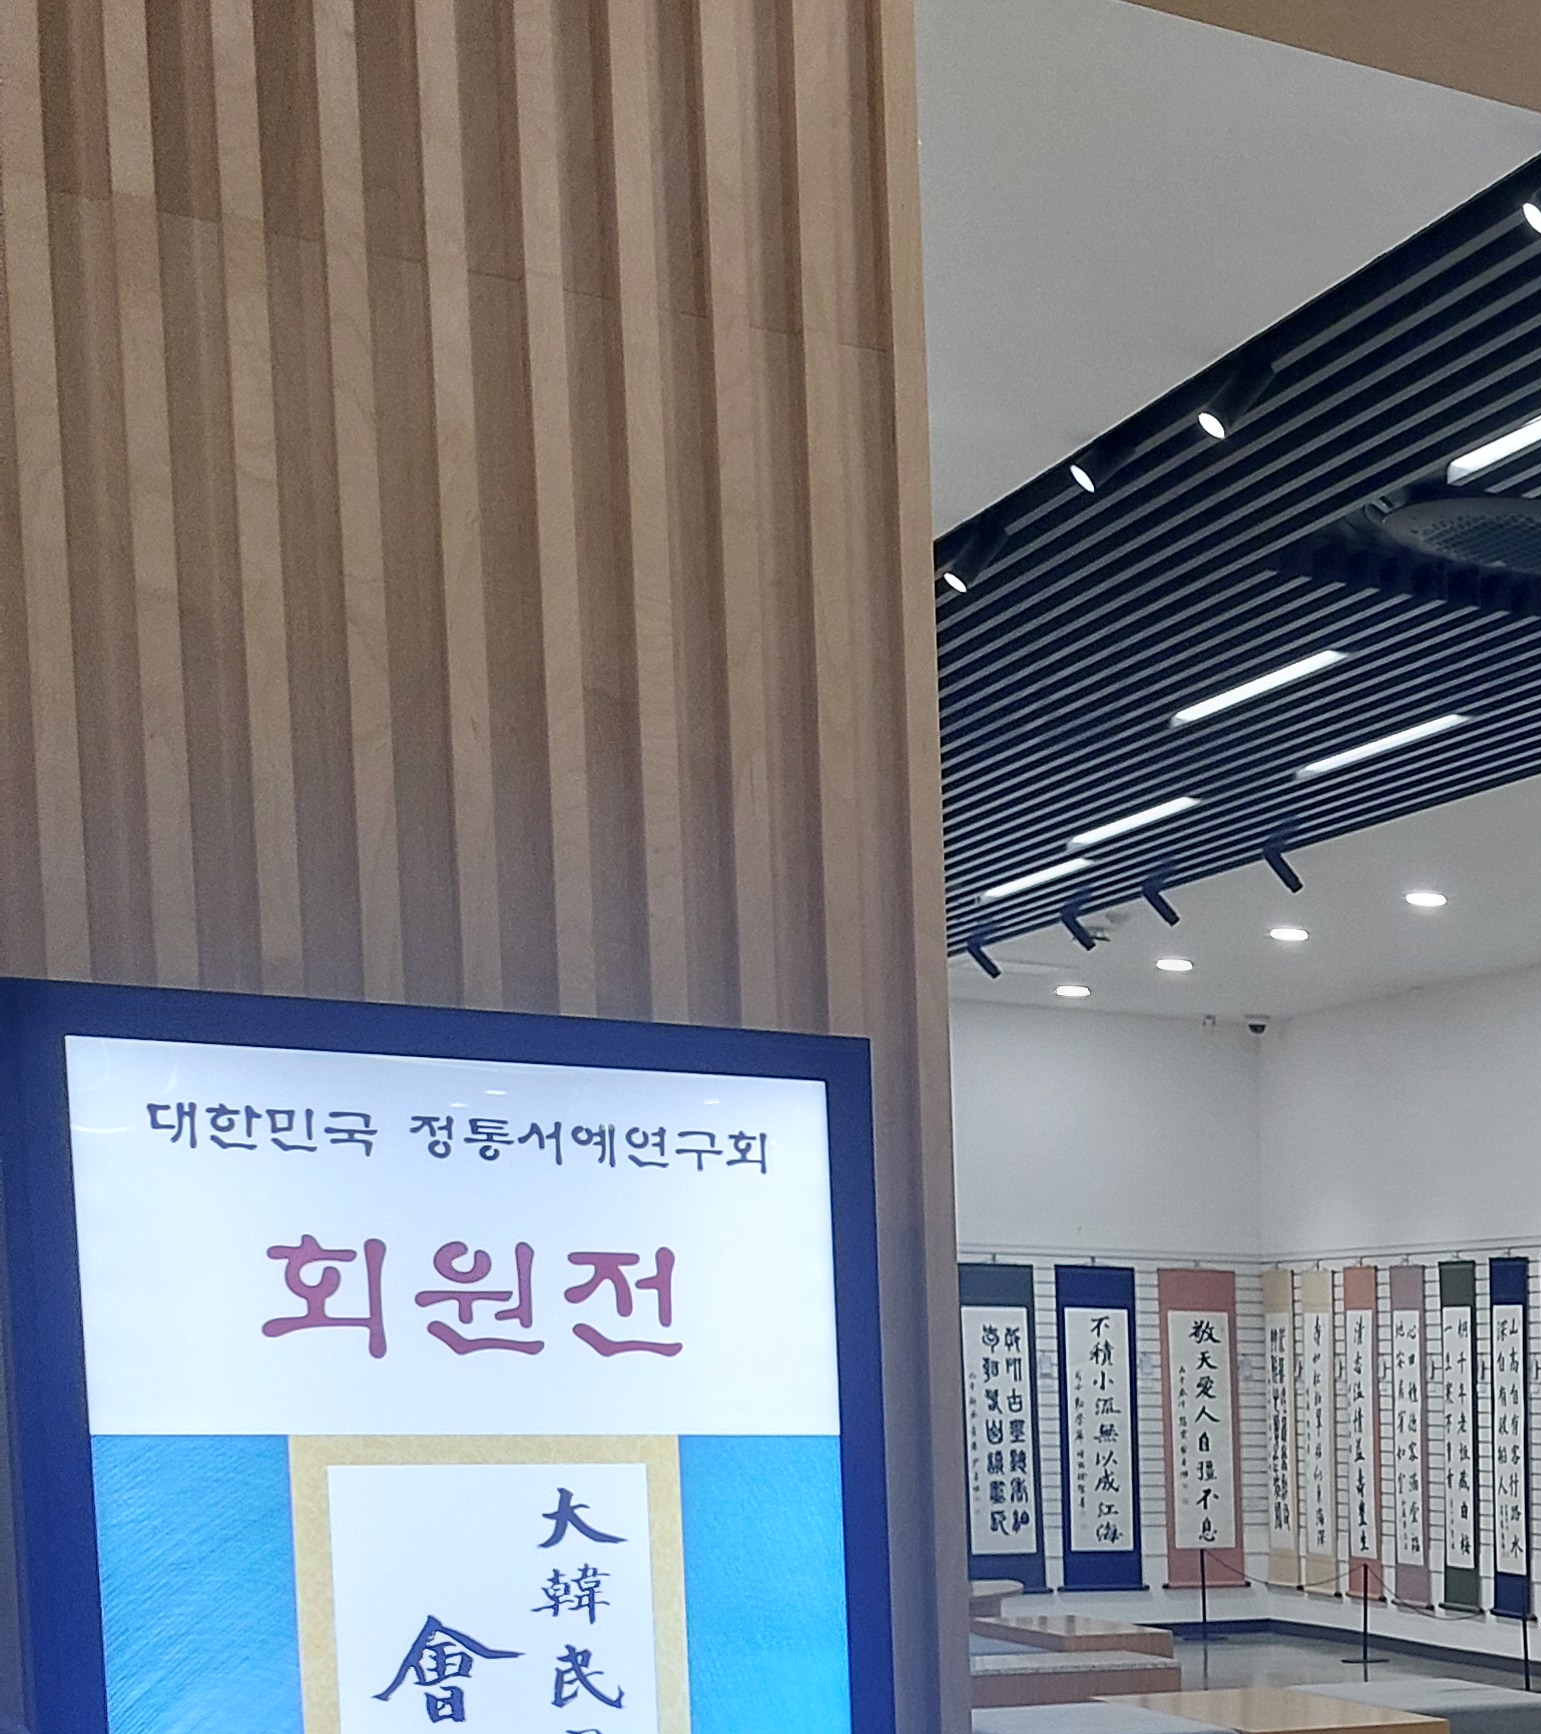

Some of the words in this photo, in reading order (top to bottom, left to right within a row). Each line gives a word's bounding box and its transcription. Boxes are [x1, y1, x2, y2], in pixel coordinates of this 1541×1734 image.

[146, 1101, 378, 1156] 대한민국
[409, 1114, 770, 1174] 정통서예연구회
[261, 1234, 684, 1359] 회원전
